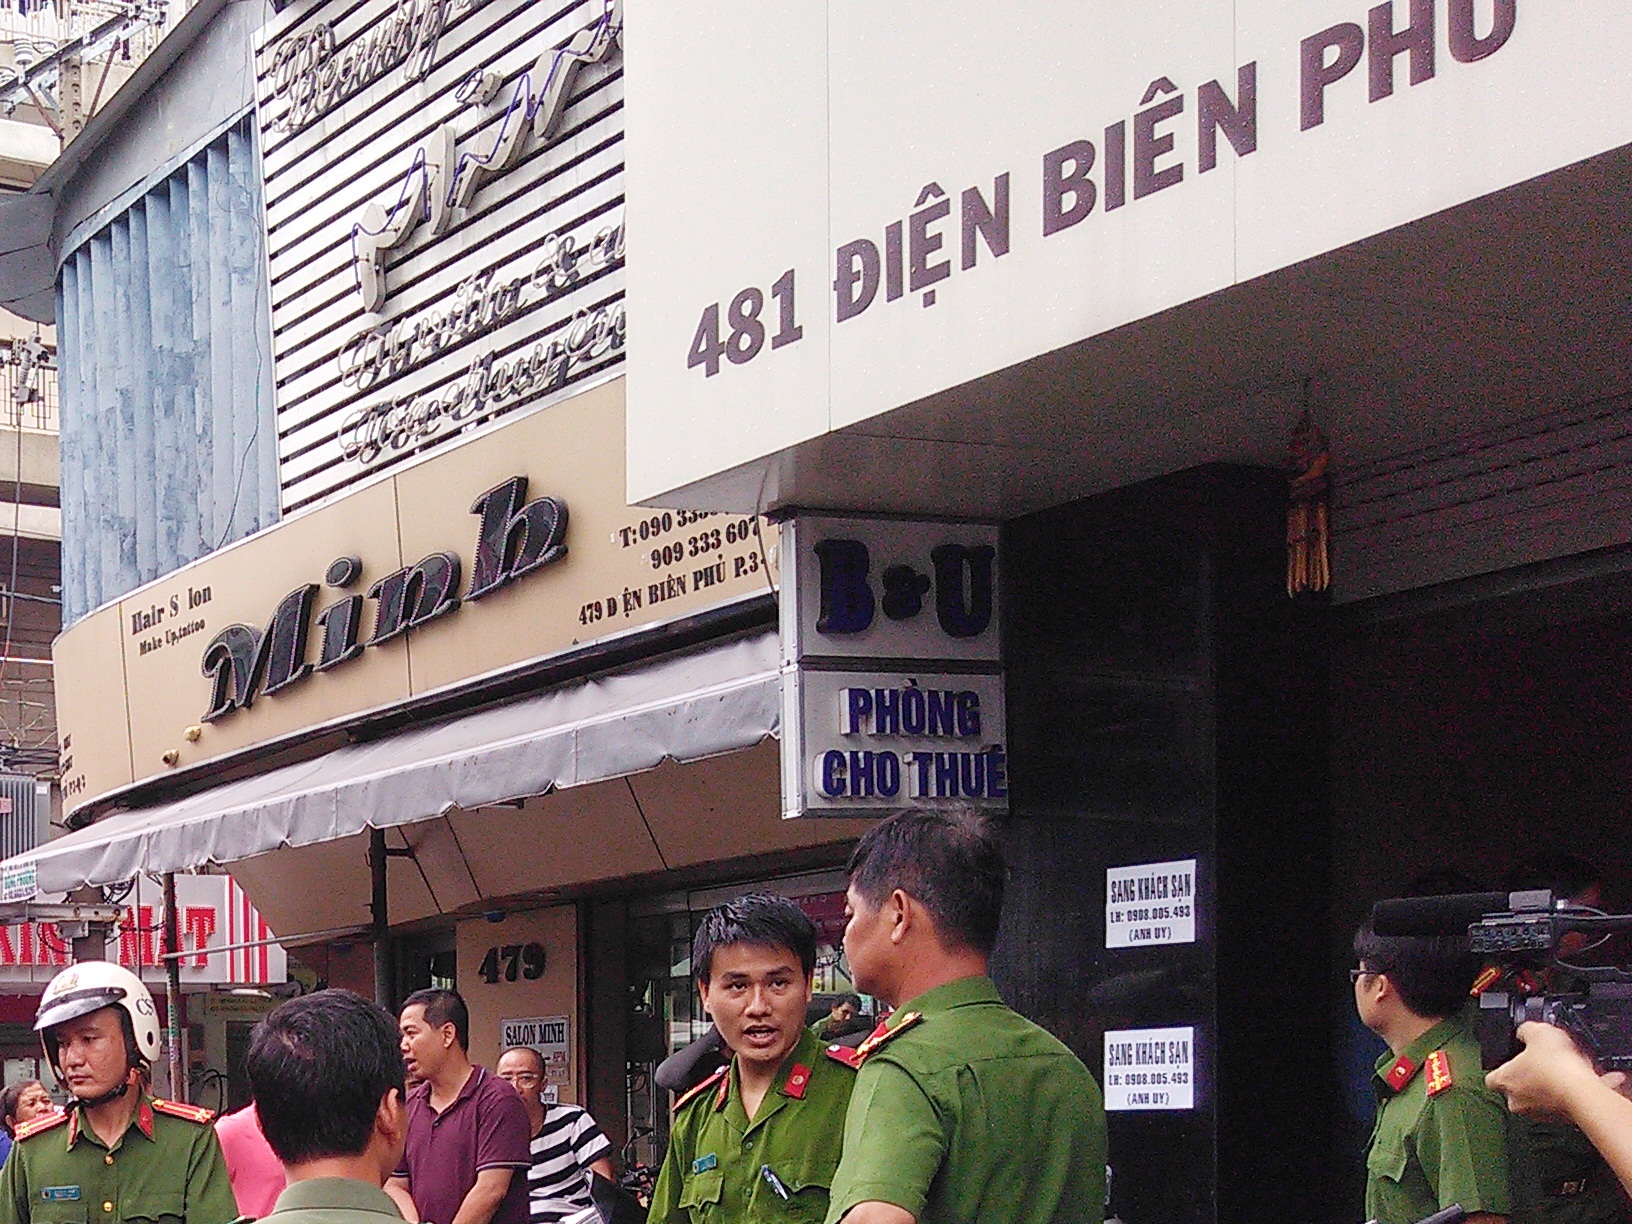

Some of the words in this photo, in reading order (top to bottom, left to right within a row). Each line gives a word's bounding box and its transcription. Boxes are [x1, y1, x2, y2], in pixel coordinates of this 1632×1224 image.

[688, 269, 804, 379] 481
[832, 173, 1010, 325] ĐIỆN
[1041, 61, 1258, 239] BIÊN
[650, 541, 684, 569] 909
[688, 528, 721, 559] 333
[726, 515, 758, 544] 607
[200, 475, 568, 722] Minh
[578, 600, 603, 625] 479
[648, 574, 687, 605] BIÊN
[693, 553, 726, 592] PHỦ
[131, 605, 164, 635] Hair
[139, 638, 162, 656] Make
[839, 678, 981, 737] PHÒNG
[818, 749, 901, 798] CHO
[910, 744, 1007, 799] THUÊ
[1111, 879, 1135, 903] SANG
[1137, 872, 1169, 901] KHÁCH
[1171, 873, 1191, 902] SẠN
[1110, 911, 1124, 923] LH:
[1129, 927, 1151, 942] (ANH
[1154, 926, 1172, 940] UY)
[478, 941, 547, 984] 479
[506, 1024, 536, 1046] SALON
[538, 1022, 565, 1044] MINH
[1109, 1043, 1133, 1066] SANG
[1135, 1037, 1166, 1065] KHÁCH
[1168, 1041, 1189, 1069] SẠN
[1109, 1074, 1122, 1086] LH:
[1125, 1072, 1189, 1086] 0908.005.493
[1127, 1092, 1149, 1106] (ANH
[1153, 1092, 1170, 1105] UY)
